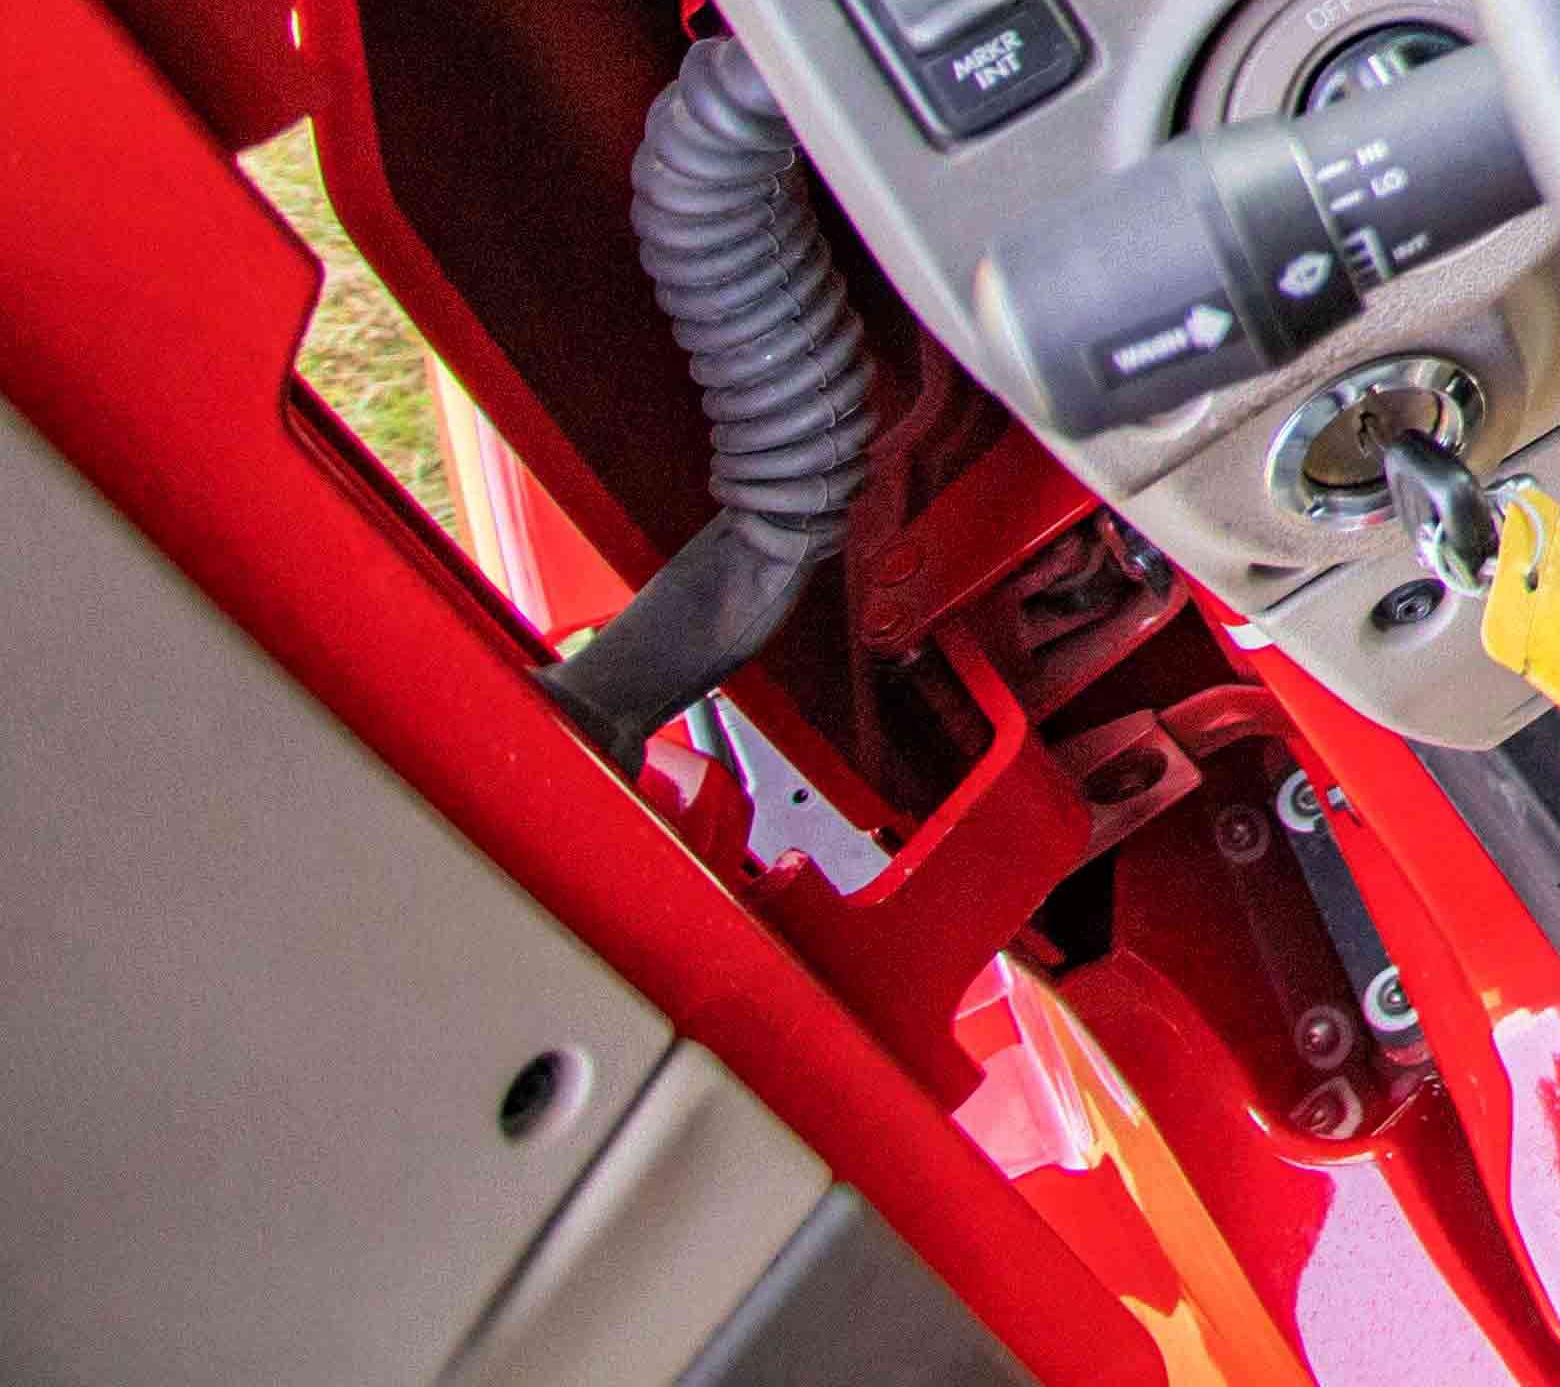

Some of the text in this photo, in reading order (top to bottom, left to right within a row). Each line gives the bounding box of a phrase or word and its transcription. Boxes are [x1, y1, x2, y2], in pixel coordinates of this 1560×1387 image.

[951, 29, 1024, 83] MRKR
[972, 52, 1021, 91] INT
[1370, 166, 1410, 198] LO
